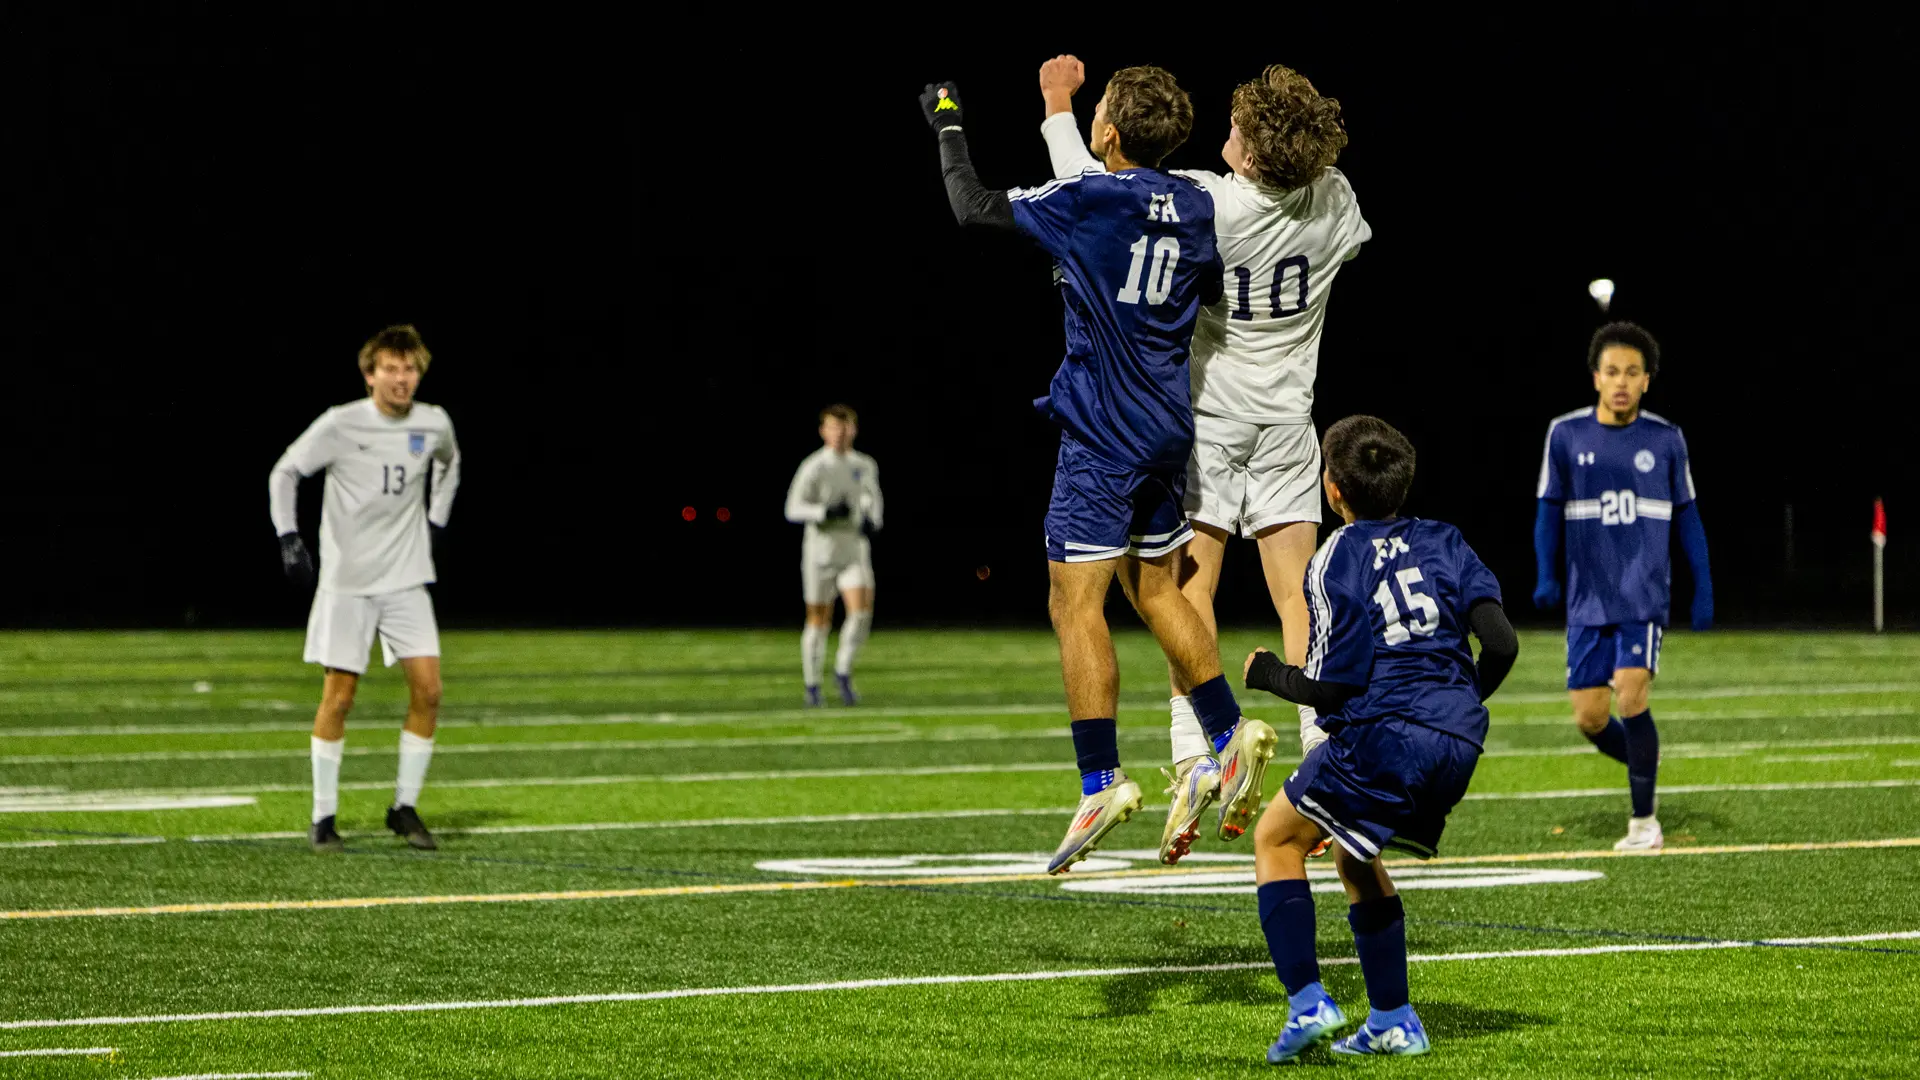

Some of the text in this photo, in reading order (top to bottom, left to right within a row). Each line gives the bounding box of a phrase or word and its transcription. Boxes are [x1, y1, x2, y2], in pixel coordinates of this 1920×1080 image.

[1147, 192, 1180, 223] FA
[1116, 235, 1180, 306] 10
[1231, 254, 1310, 321] 10
[382, 465, 406, 496] 13
[1601, 489, 1637, 526] 20
[1373, 566, 1440, 647] 15
